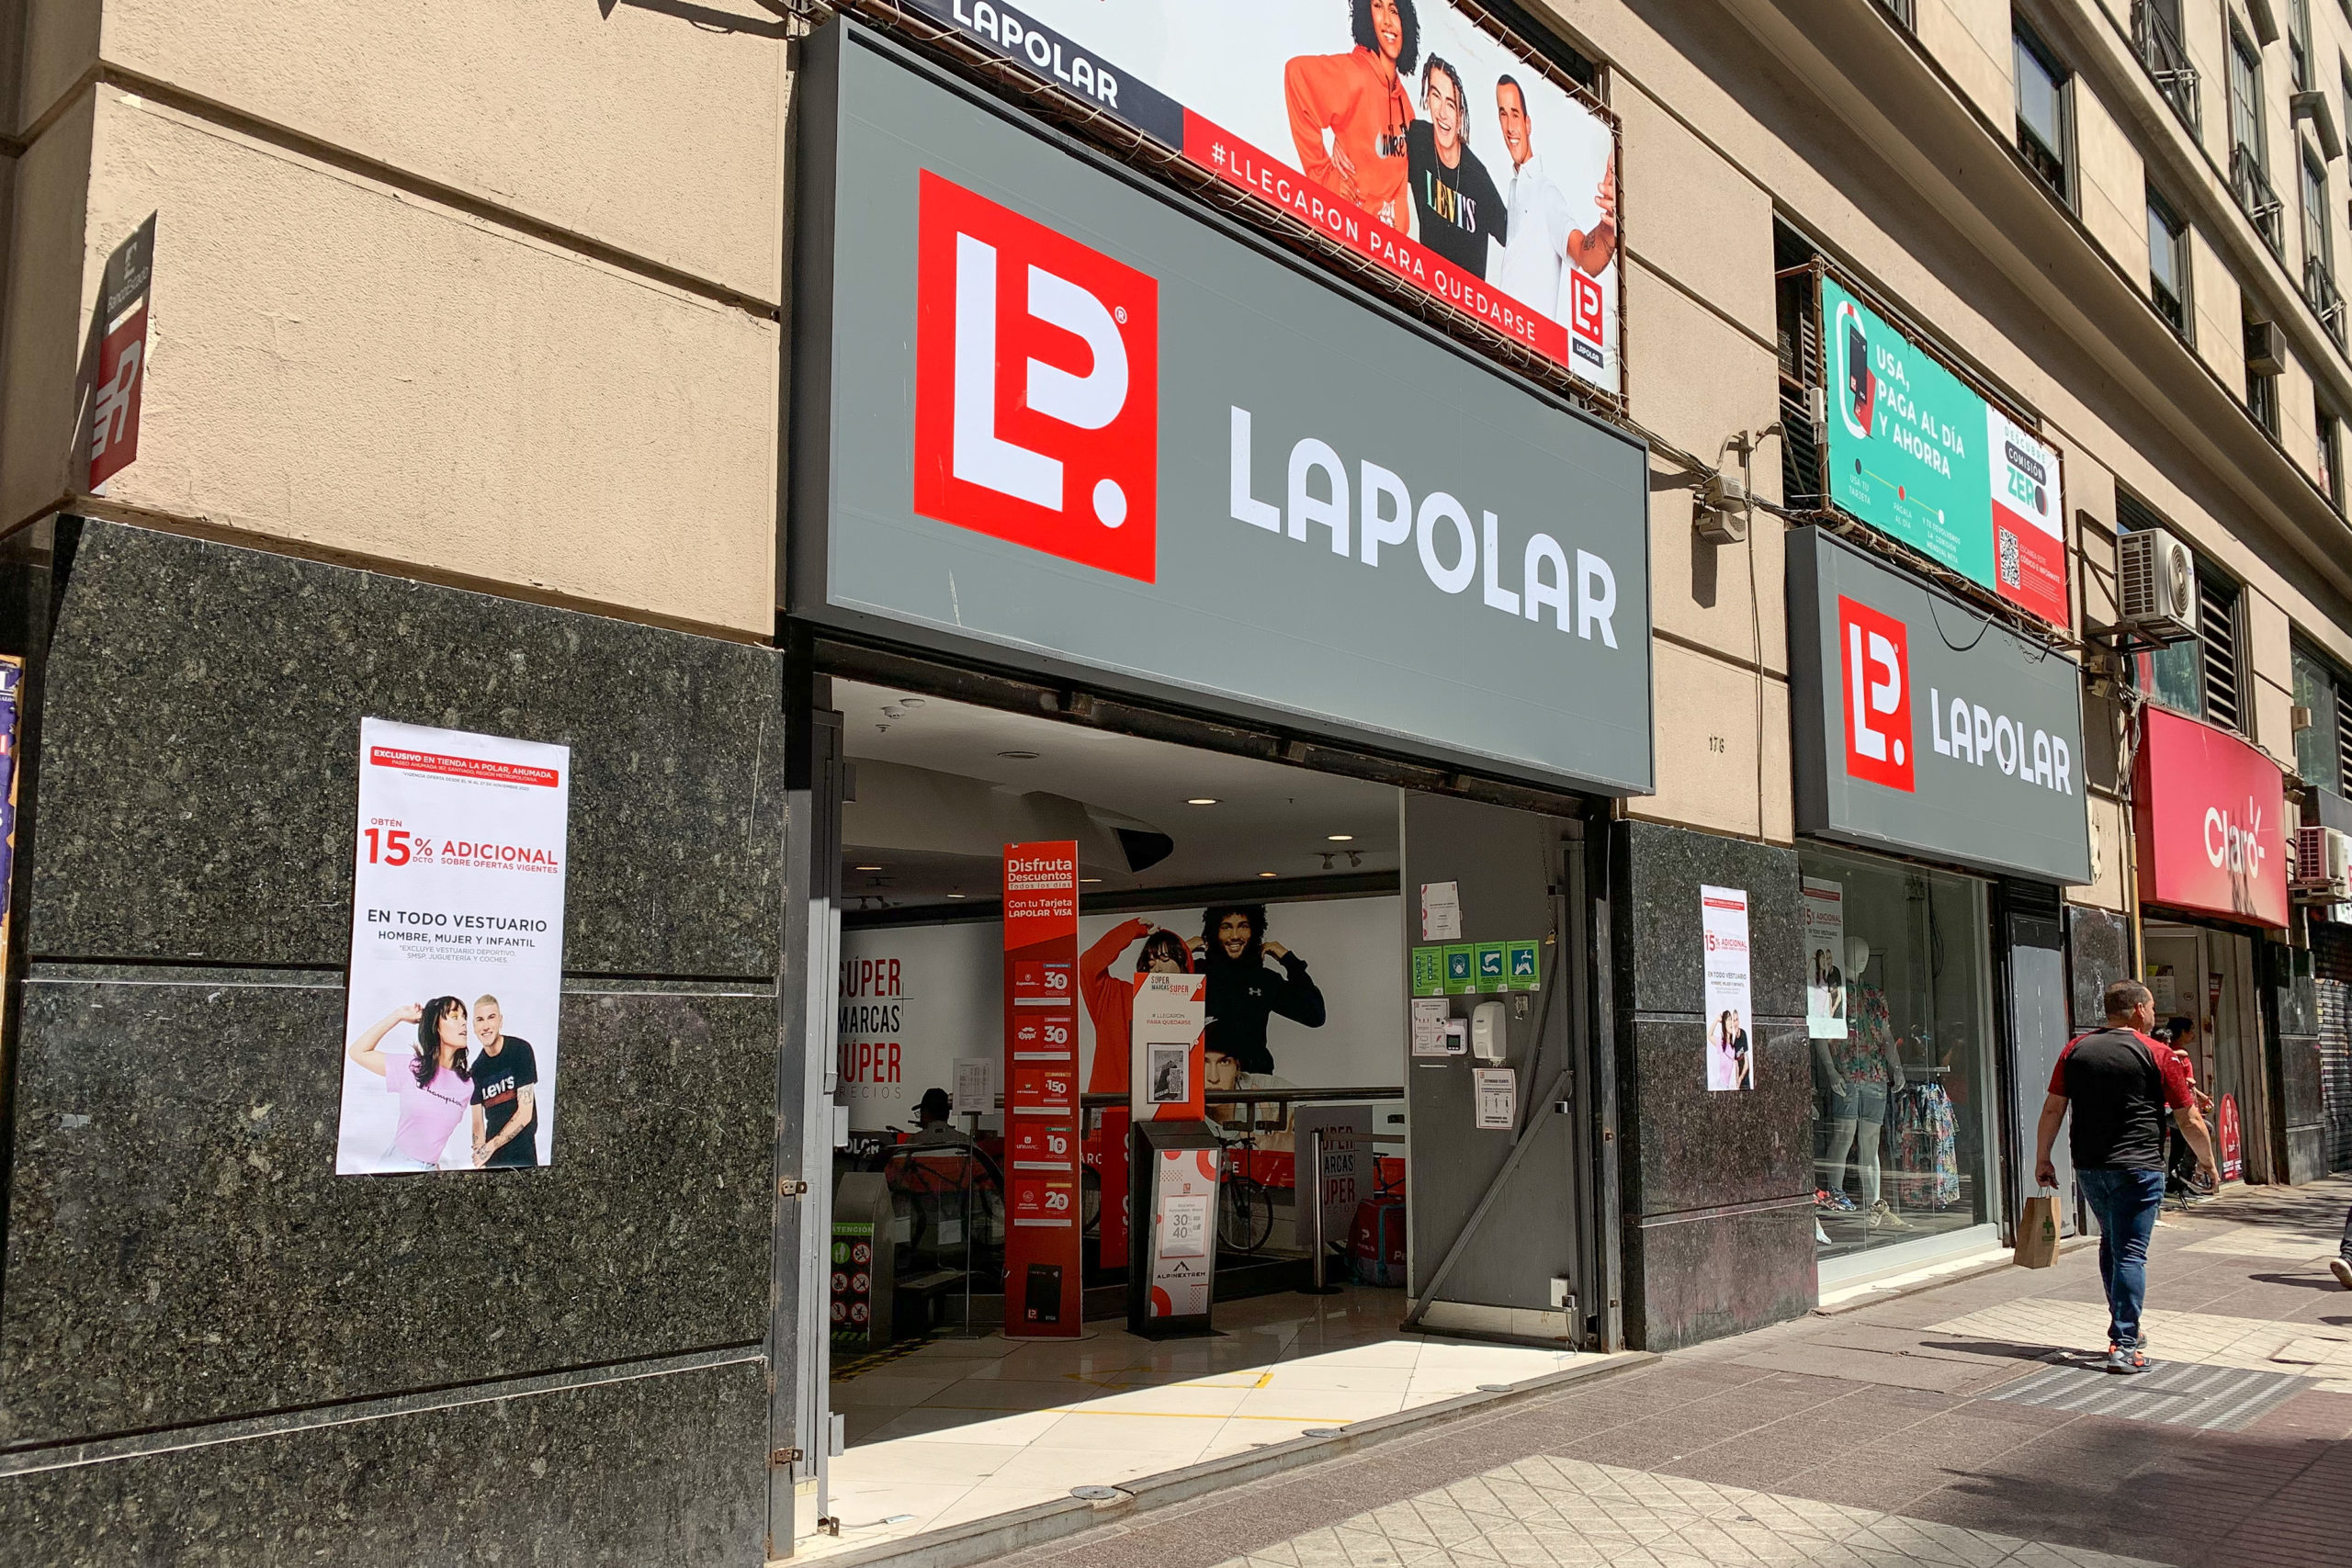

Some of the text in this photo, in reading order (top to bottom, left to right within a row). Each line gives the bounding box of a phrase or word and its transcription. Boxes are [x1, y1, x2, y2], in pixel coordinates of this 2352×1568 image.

[953, 0, 1118, 109] LAPOLAR
[1425, 169, 1477, 233] LEVI'S
[1211, 141, 1359, 243] #LLEGARON
[1370, 231, 1425, 280] PARA
[1434, 270, 1536, 342] QUEDARSE
[1875, 344, 1911, 392] USA,
[1877, 378, 1965, 459] PAGA AL DÍA
[1878, 411, 1951, 479] Y AHORRA
[2004, 425, 2046, 464] DESCUBRE
[2008, 447, 2043, 480] COMISIÓN
[1229, 404, 1620, 649] LAPOLAR
[1709, 737, 1724, 753] 176
[1930, 687, 2073, 795] LAPOLAR
[374, 750, 422, 761] EXCLUSIVO
[424, 756, 435, 764] EN
[436, 758, 468, 768] TIENDA
[469, 761, 480, 770] LA
[481, 763, 511, 774] POLAR,
[370, 818, 402, 827] OBTÉN
[441, 840, 559, 865] ADICIONAL
[2204, 803, 2262, 879] Claro
[441, 857, 470, 866] SOBRE
[473, 860, 514, 870] OFERTAS
[516, 863, 559, 874] VIGENTES
[1008, 858, 1073, 873] Disfruta
[1008, 872, 1072, 882] Descuentos
[1008, 900, 1026, 908] Con
[1039, 898, 1072, 908] Tarjeta
[1008, 909, 1050, 918] LAPOLAR
[368, 908, 547, 932] EN TODO VESTUARIO
[378, 931, 536, 947] HOMBRE, MUJER Y INFANTIL
[435, 946, 475, 954] VESTUARIO
[425, 1086, 464, 1108] hampion
[838, 1086, 901, 1100] RECIOS
[1324, 1154, 1354, 1173] ARCAS
[1157, 1271, 1206, 1280] ALPINEXTREM
